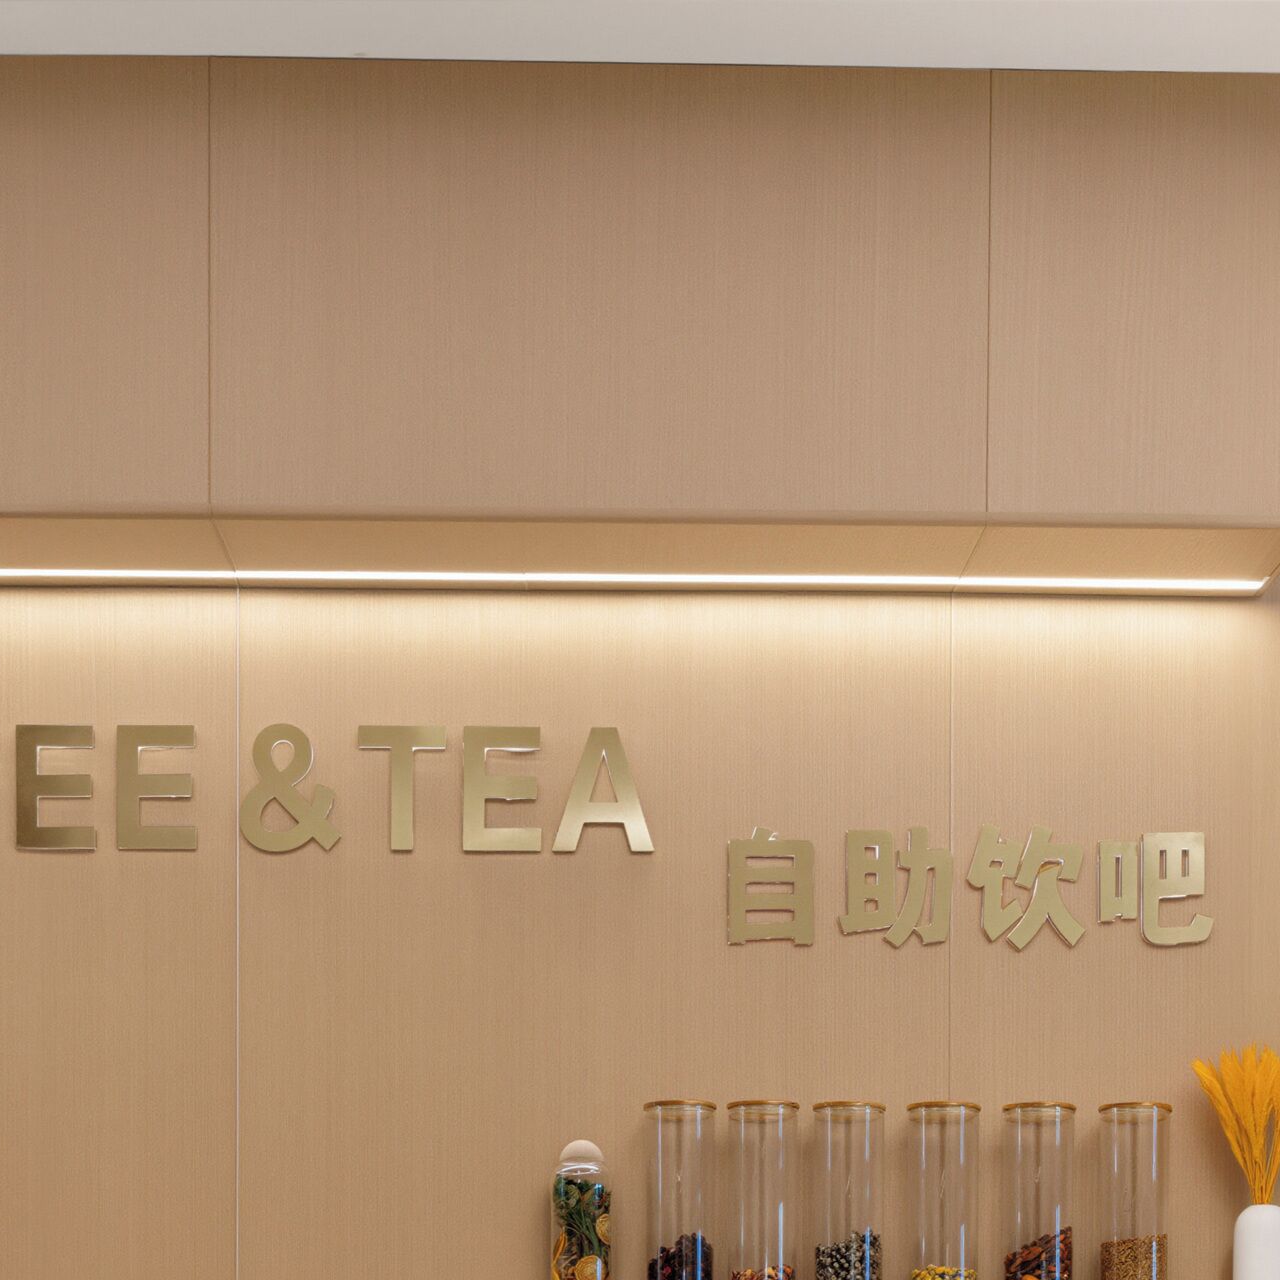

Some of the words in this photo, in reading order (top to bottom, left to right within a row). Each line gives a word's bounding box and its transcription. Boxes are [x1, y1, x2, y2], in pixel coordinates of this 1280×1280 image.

[239, 723, 341, 853] &
[358, 725, 655, 853] TEA
[727, 825, 1214, 951] 自助饮吧
